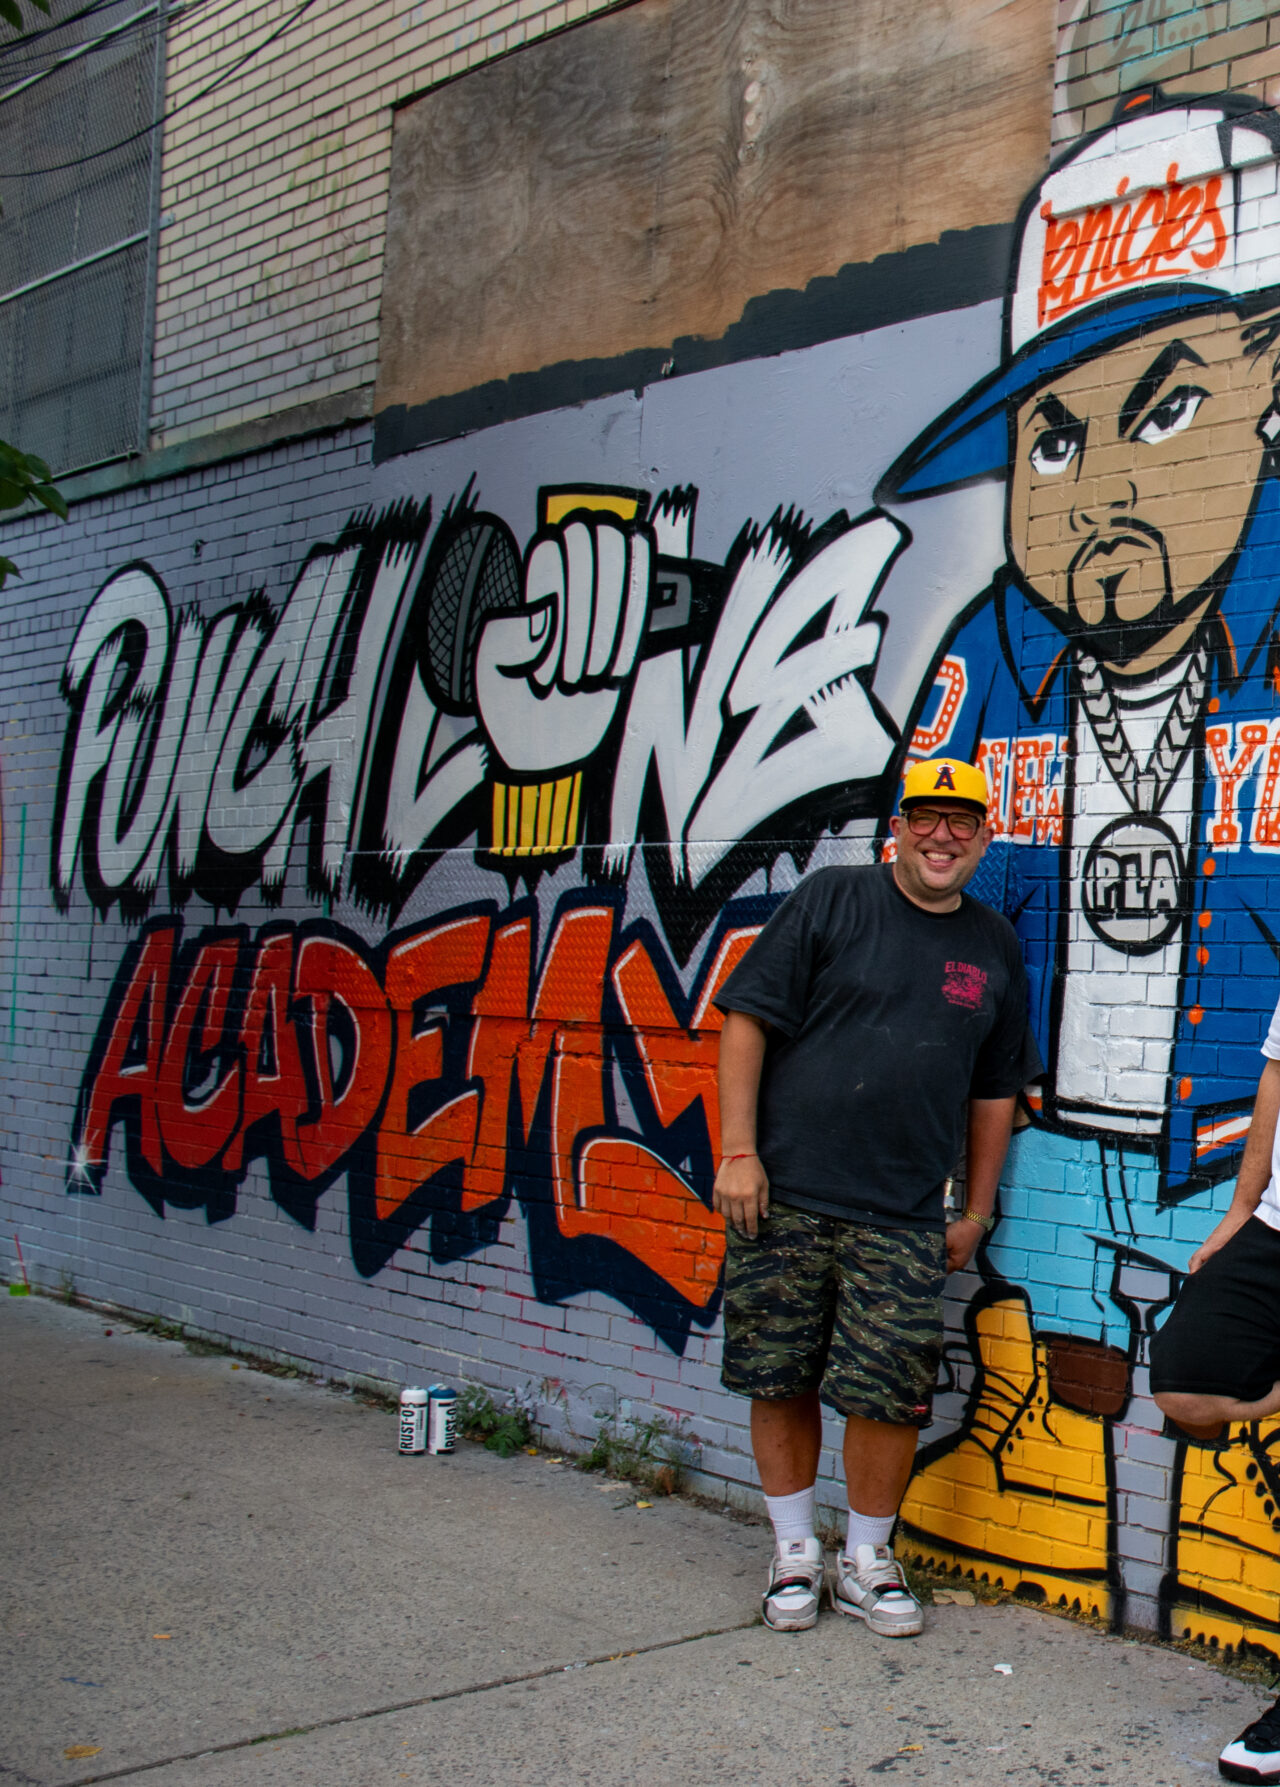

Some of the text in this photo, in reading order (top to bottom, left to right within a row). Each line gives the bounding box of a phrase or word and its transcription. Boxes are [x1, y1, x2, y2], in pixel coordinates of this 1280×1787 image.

[933, 762, 956, 791] A
[1093, 850, 1180, 922] PLA
[72, 893, 768, 1330] ACADEMY
